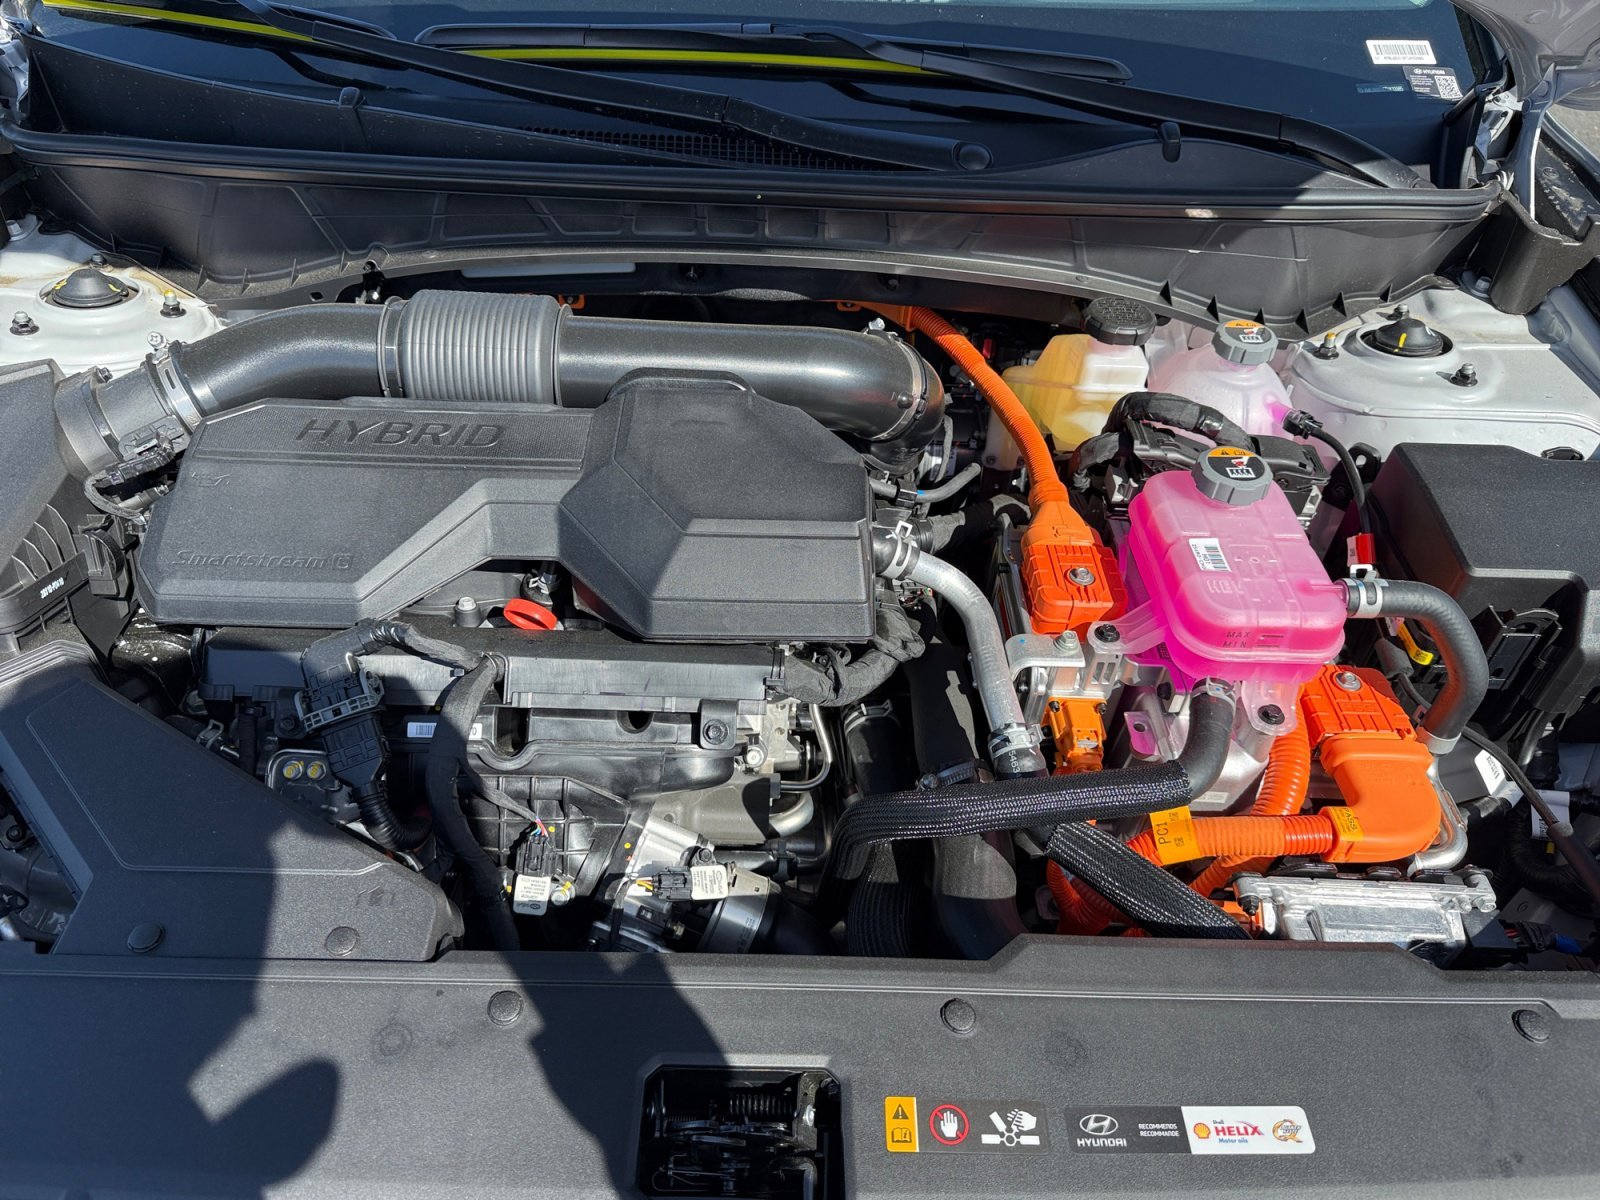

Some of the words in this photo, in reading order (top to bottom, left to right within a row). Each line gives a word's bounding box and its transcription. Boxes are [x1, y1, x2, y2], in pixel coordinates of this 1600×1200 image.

[296, 418, 506, 447] HYBRID
[172, 550, 328, 568] Smartstream
[1226, 631, 1251, 639] MAX
[1009, 750, 1020, 773] 5463
[1156, 822, 1171, 845] PC1
[1214, 1125, 1263, 1137] HELIX
[1076, 1138, 1128, 1147] HYUNDAI
